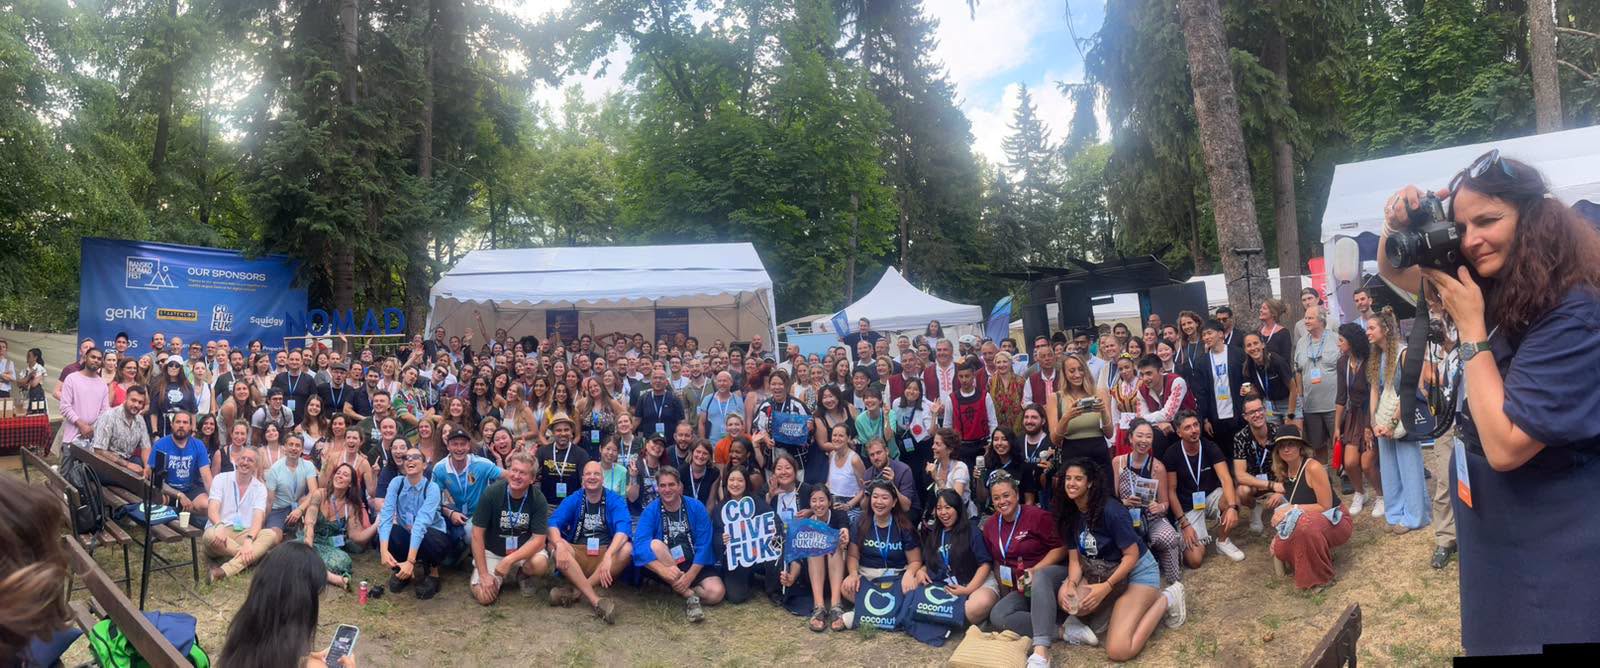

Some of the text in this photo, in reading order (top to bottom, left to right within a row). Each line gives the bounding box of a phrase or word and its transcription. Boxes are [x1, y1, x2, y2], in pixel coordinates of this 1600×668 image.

[187, 267, 266, 281] OUR SPONSORS
[105, 306, 148, 321] genki
[213, 312, 233, 322] LIVE
[249, 316, 285, 327] Squidgy
[285, 307, 405, 337] NOMAD
[104, 339, 138, 349] myOS
[724, 497, 755, 522] CO
[727, 512, 776, 544] LIVE
[730, 536, 777, 567] FUK
[917, 602, 954, 614] coconut
[860, 615, 897, 625] coconut
